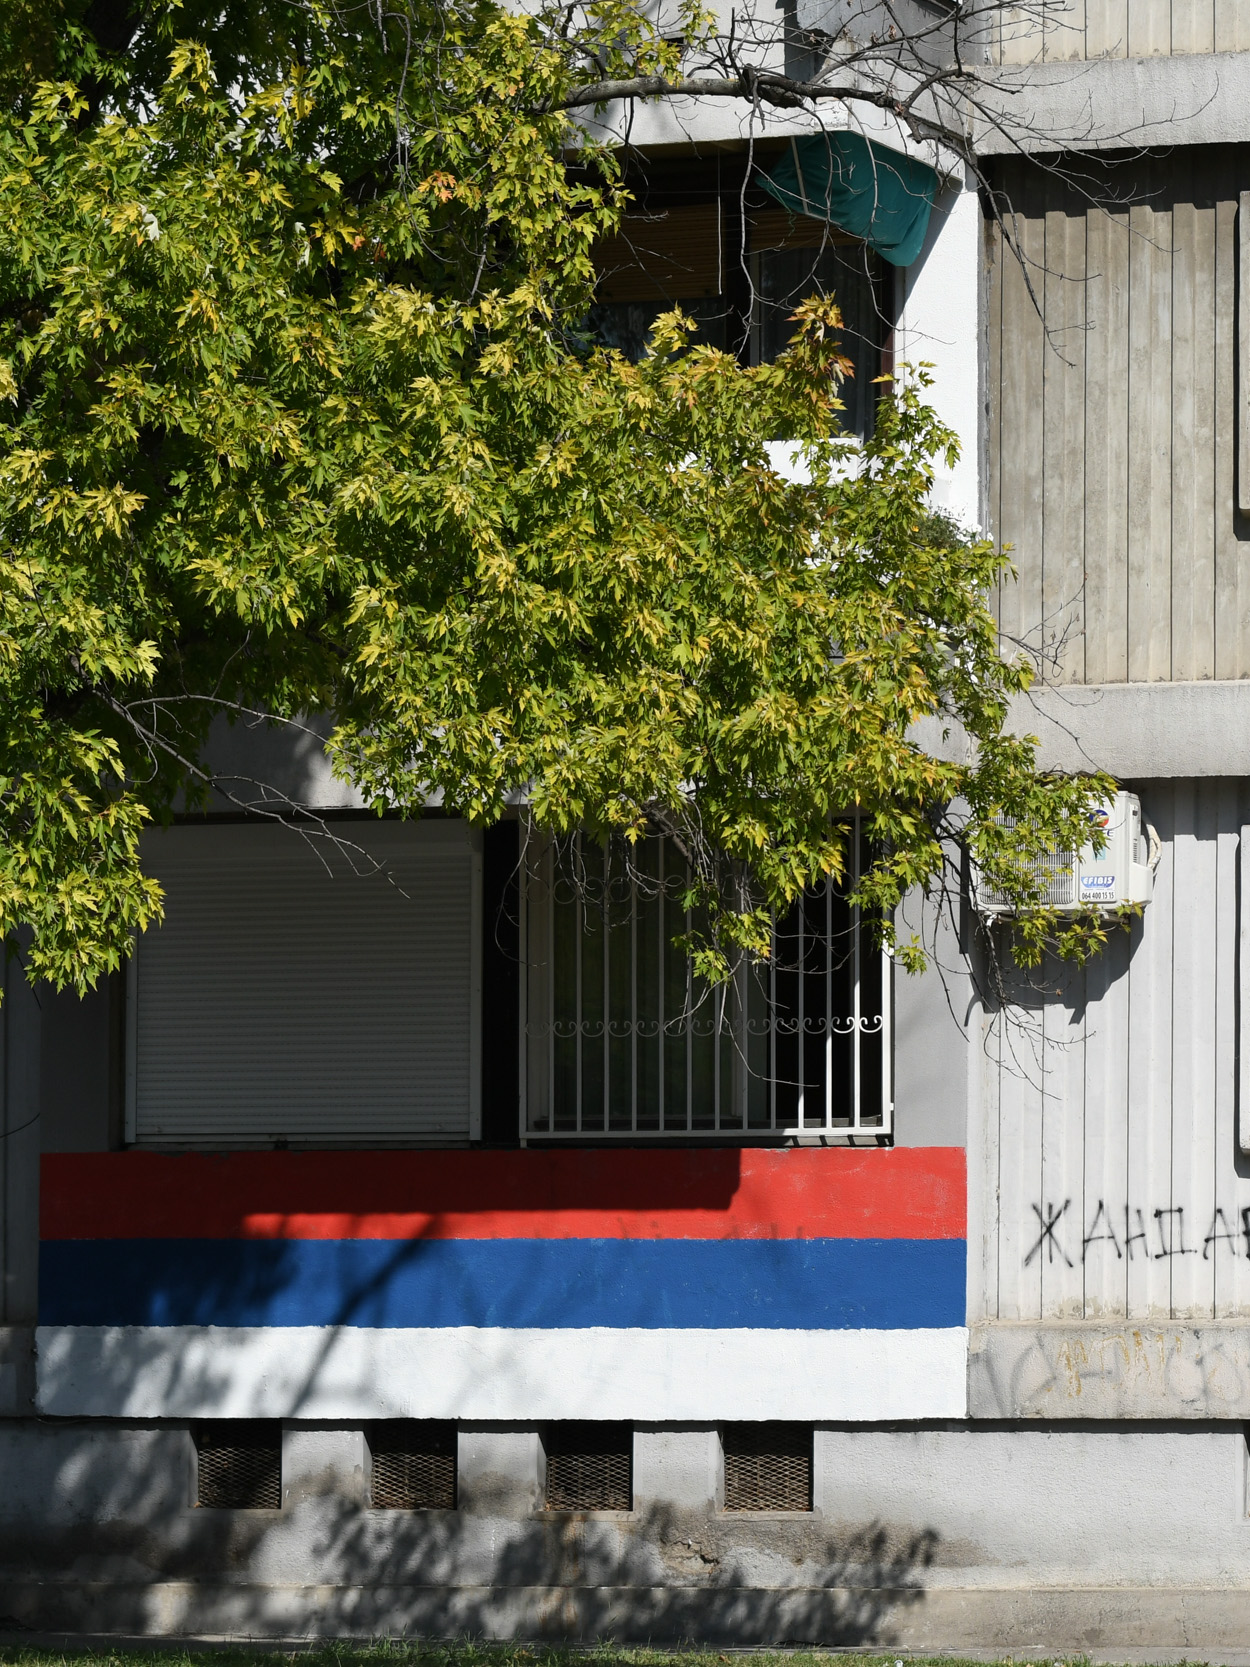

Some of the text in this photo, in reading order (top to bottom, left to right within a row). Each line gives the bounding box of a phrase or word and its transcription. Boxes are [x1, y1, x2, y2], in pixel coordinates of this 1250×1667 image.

[1081, 891, 1115, 900] 064 400 15 15
